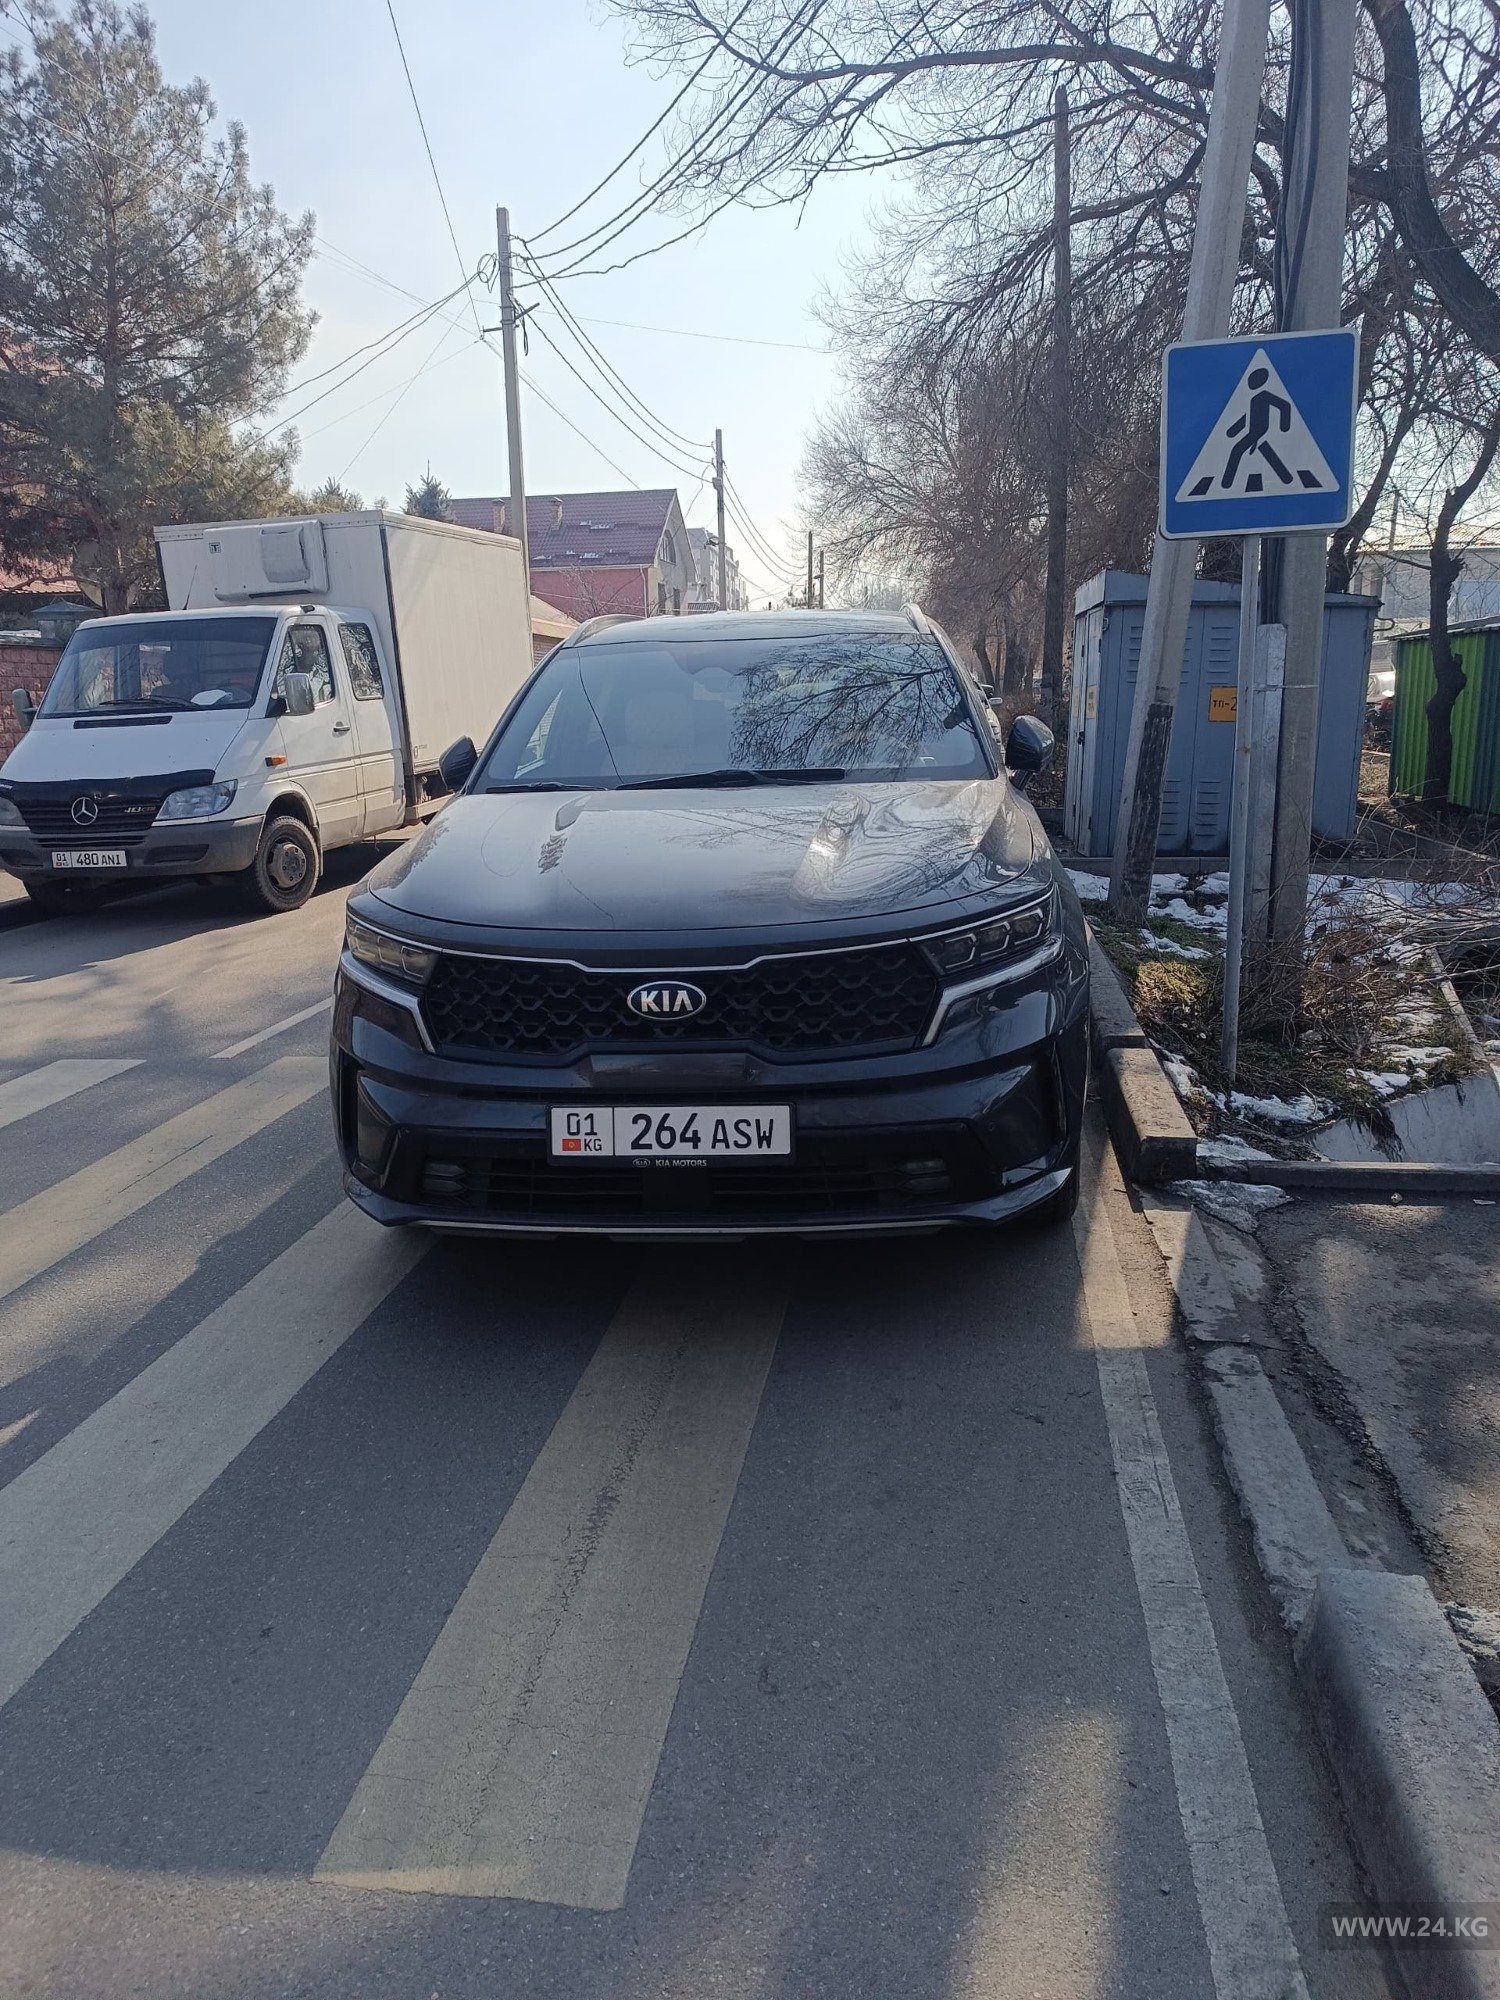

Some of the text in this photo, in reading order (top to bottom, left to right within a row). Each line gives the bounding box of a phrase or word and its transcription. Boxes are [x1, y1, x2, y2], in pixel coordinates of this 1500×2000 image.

[56, 853, 67, 862] 01
[77, 853, 121, 866] 480 ANI
[640, 990, 694, 1013] KIA
[566, 1112, 598, 1137] 01
[630, 1112, 775, 1151] 264 ASW
[583, 1138, 603, 1152] KG
[655, 1159, 707, 1167] KIA MOTORS
